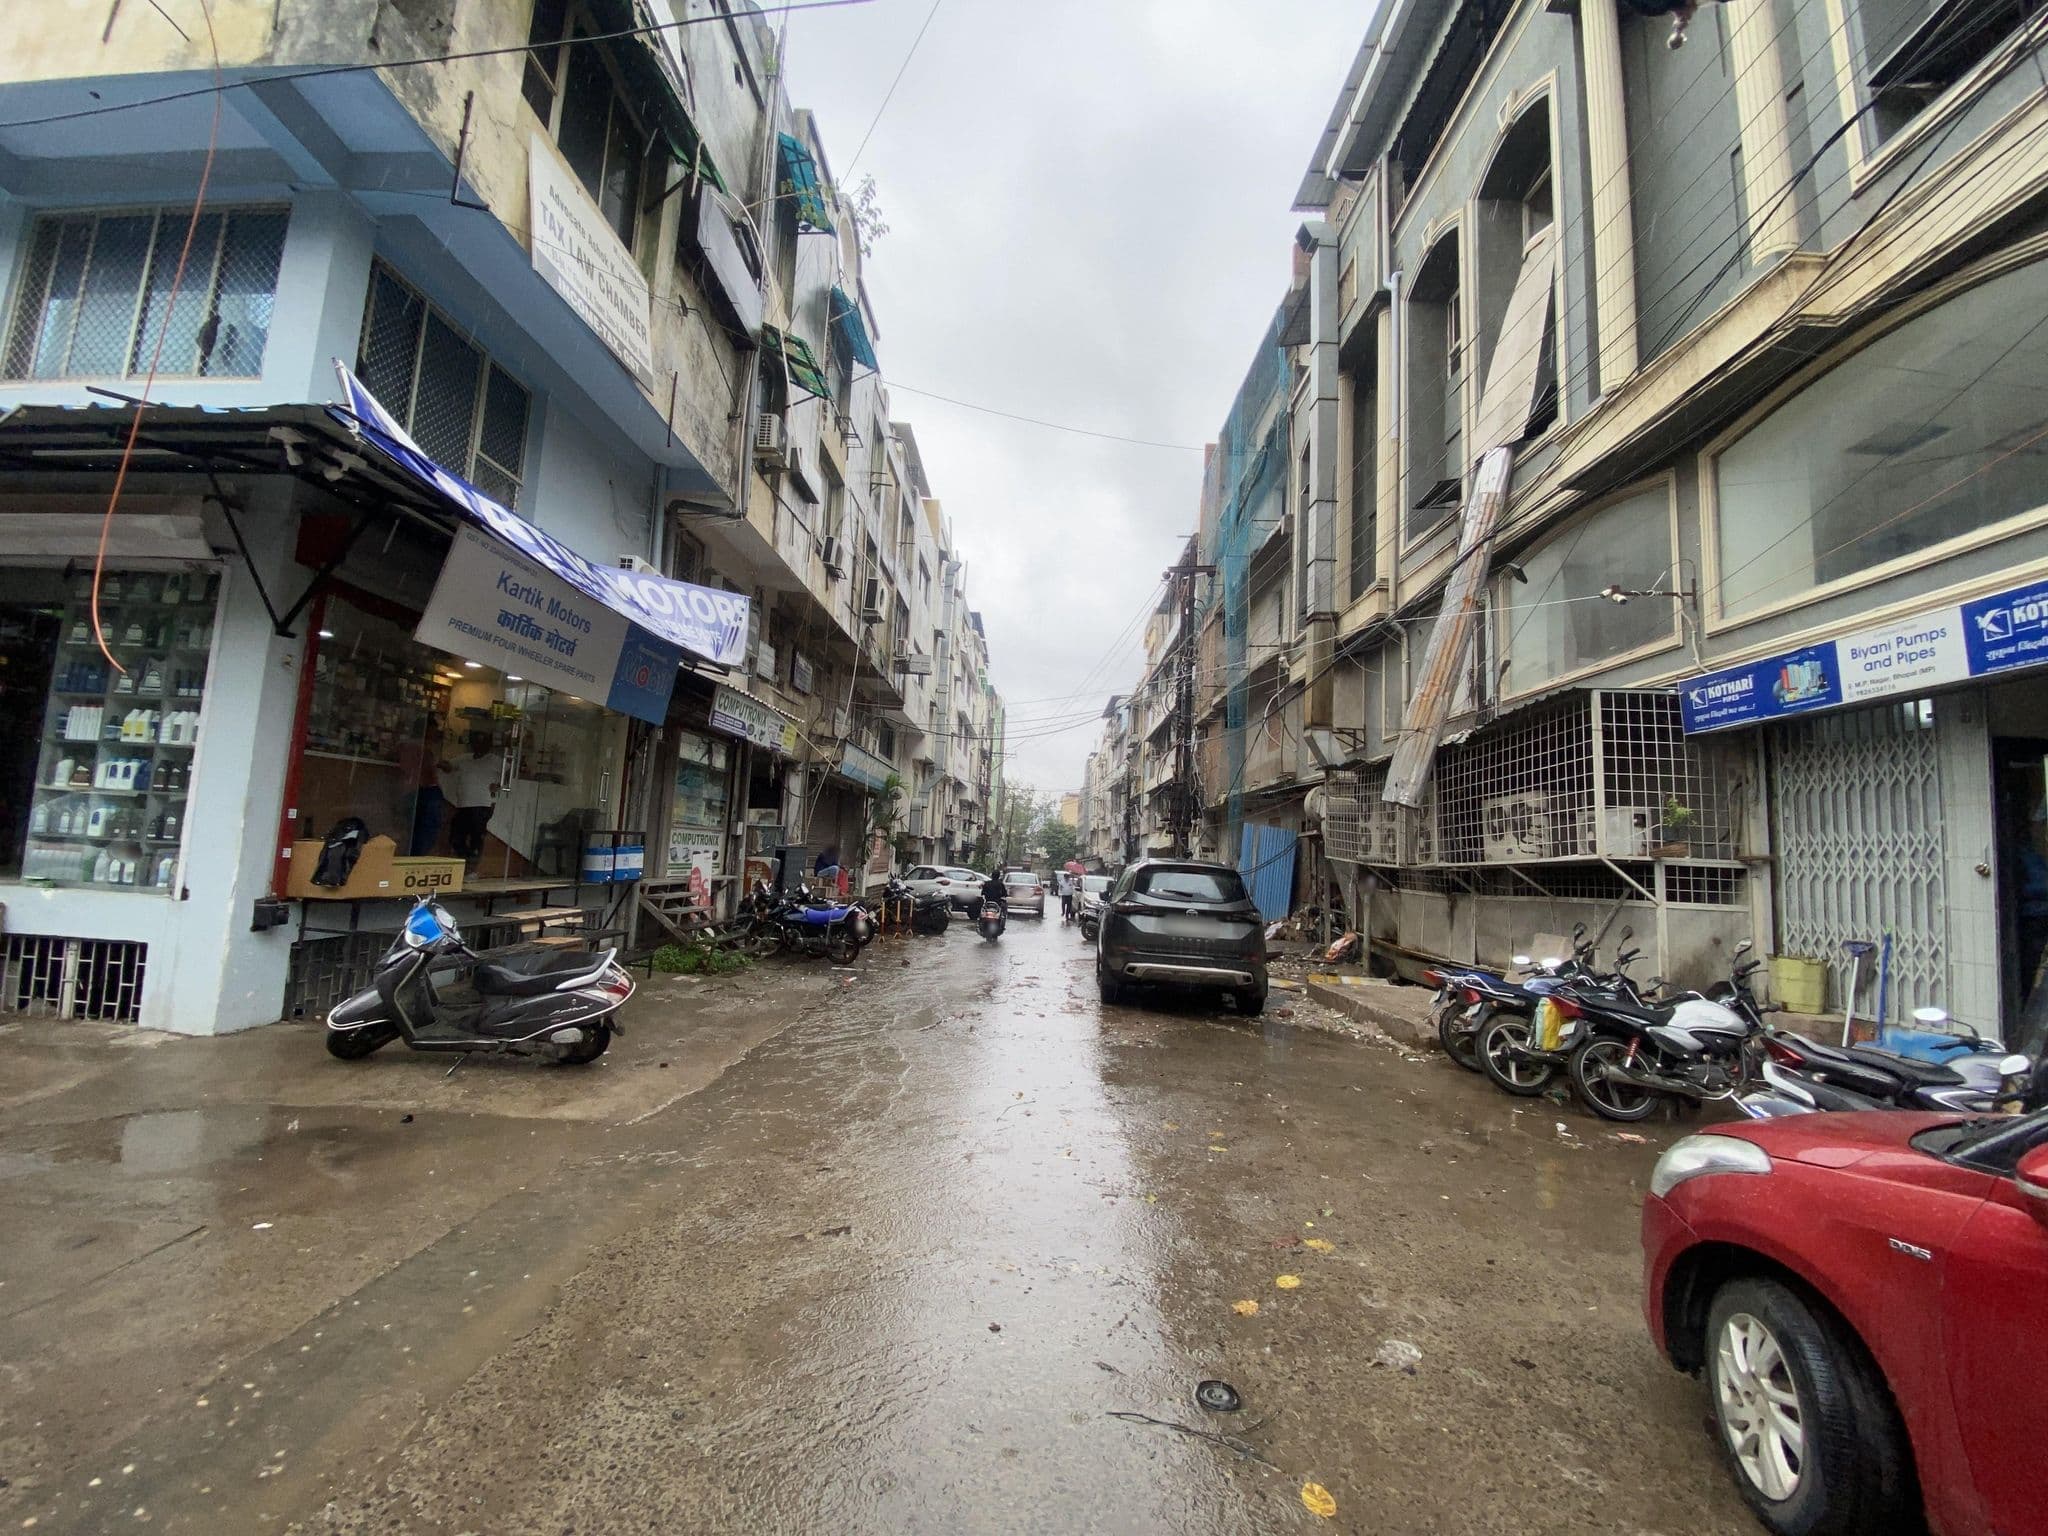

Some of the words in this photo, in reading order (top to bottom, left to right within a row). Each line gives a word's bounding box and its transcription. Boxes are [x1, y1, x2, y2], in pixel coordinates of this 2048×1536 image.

[540, 201, 566, 247] TAX
[568, 236, 595, 281] LAW
[598, 272, 648, 345] CHAMBER
[622, 348, 641, 375] GST
[496, 570, 544, 609] Kartik
[546, 597, 592, 634] Motors
[447, 617, 493, 642] PREMIUM
[493, 636, 518, 652] FOUR
[518, 643, 553, 668] WHEELER
[496, 609, 545, 641] कार्तिक
[545, 629, 578, 656] मोटर्स
[1850, 641, 1891, 660] Biyani
[1896, 627, 1947, 649] Pumps
[1863, 656, 1892, 672] and
[1897, 647, 1936, 665] Pipes
[1708, 675, 1753, 698] KOTHARI
[1722, 694, 1739, 703] PIPES
[404, 873, 452, 888] DEPO
